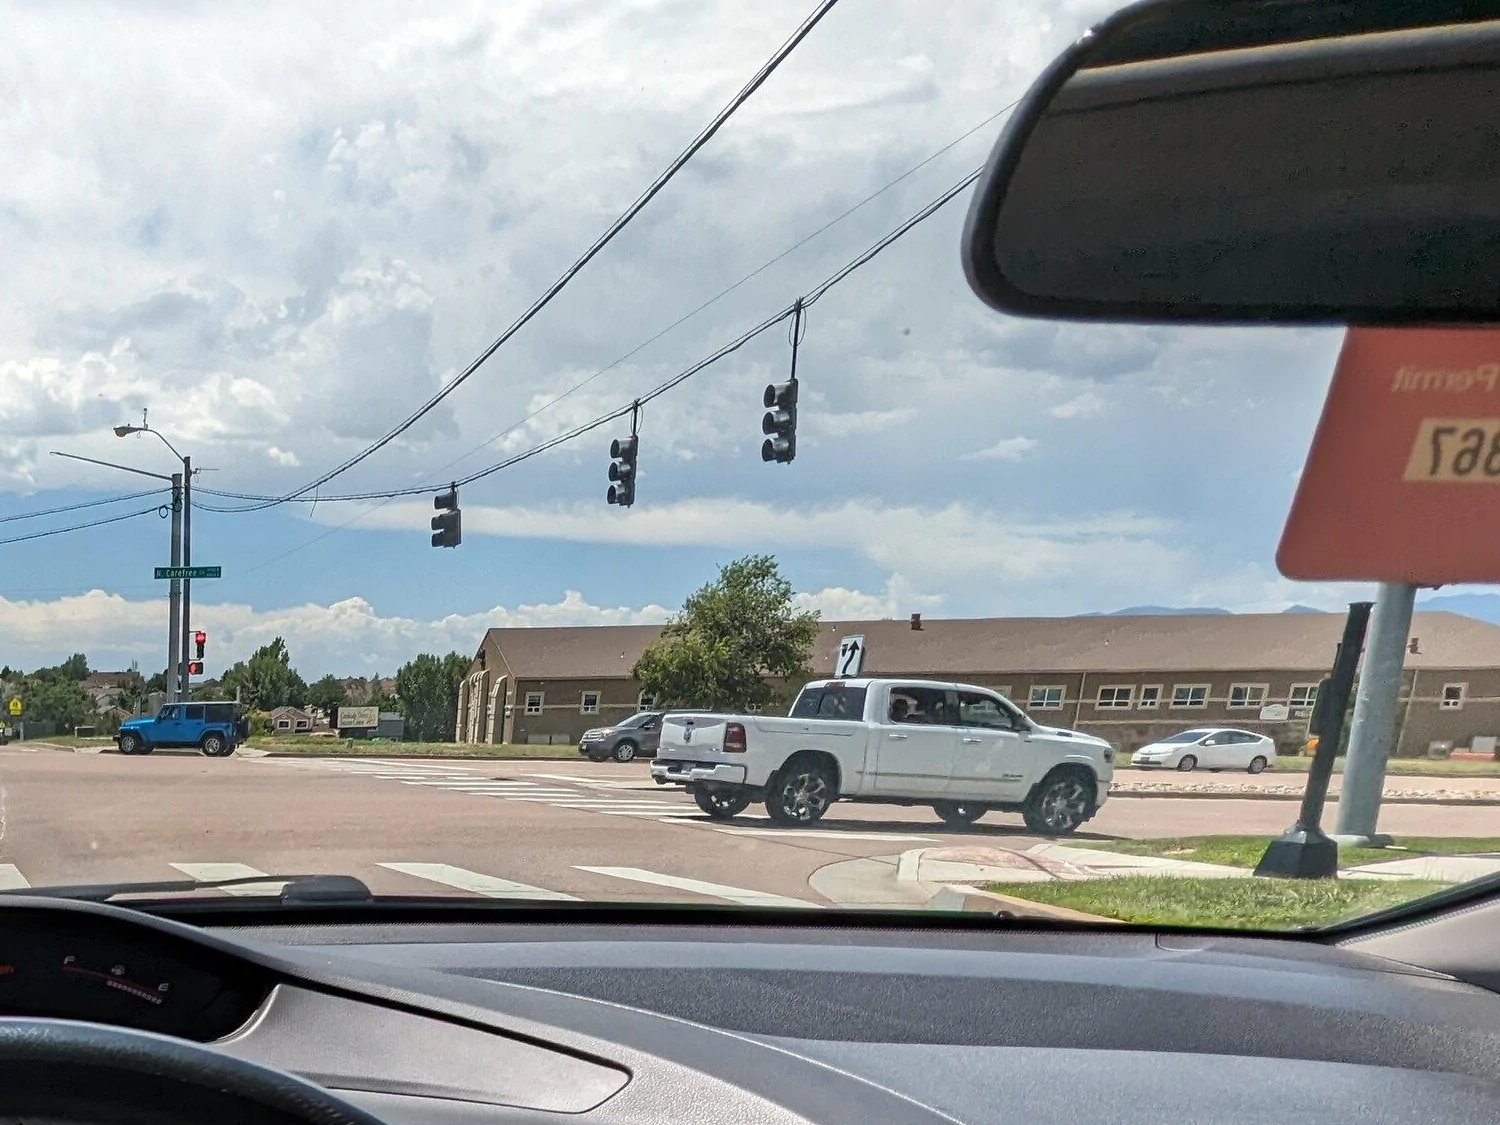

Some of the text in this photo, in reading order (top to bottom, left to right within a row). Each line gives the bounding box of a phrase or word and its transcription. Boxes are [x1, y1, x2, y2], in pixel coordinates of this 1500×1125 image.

[165, 569, 197, 577] Carefree
[63, 955, 77, 965] F
[156, 982, 169, 992] E
